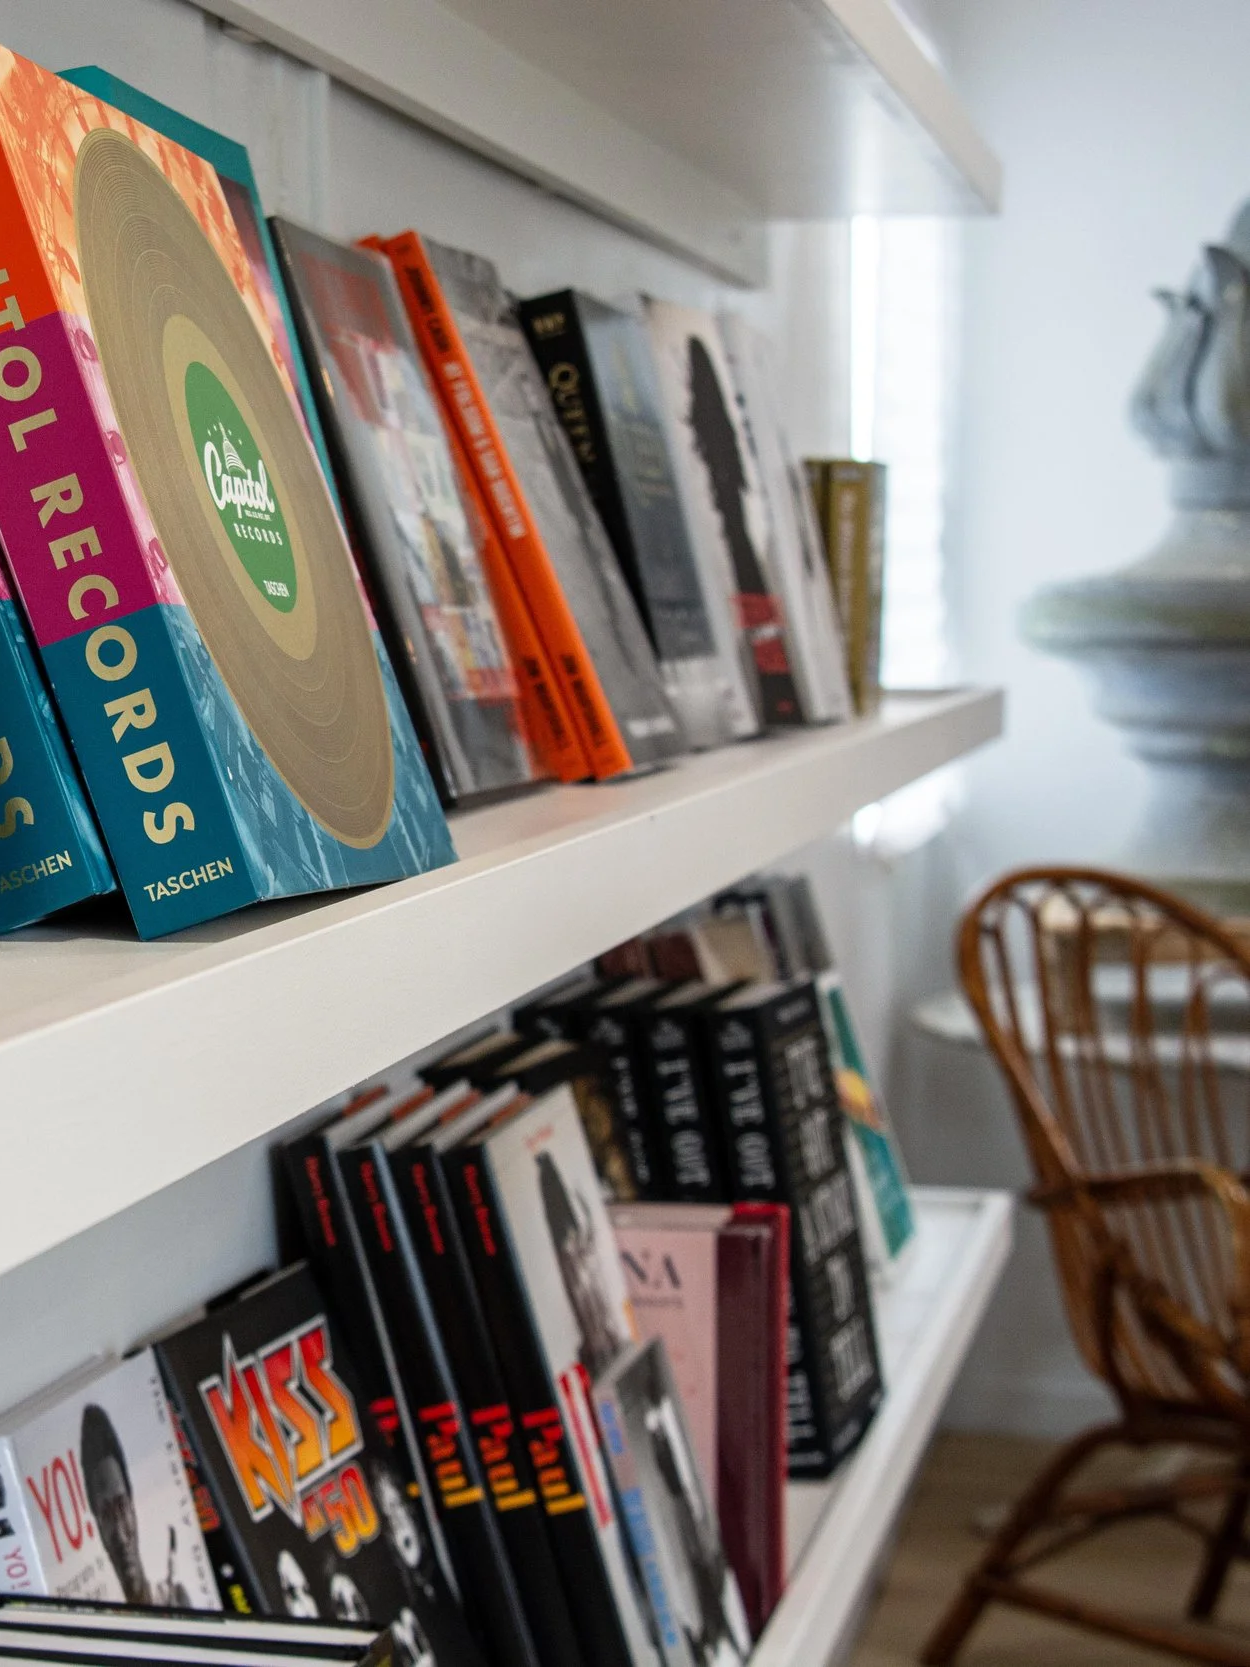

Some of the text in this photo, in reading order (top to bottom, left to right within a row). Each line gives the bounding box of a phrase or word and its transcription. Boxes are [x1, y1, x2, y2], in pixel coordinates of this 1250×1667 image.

[204, 440, 276, 519] Capitol
[233, 522, 283, 546] RECORDS
[263, 579, 290, 597] TASCHEN
[30, 472, 195, 845] RECORDS
[143, 857, 234, 902] TASCHEN
[197, 1312, 365, 1531] KISS
[419, 1401, 485, 1509] Paul
[470, 1403, 537, 1512] Paul
[521, 1406, 587, 1516] Paul
[25, 1448, 94, 1565] YO!
[3, 1545, 31, 1591] YO!
